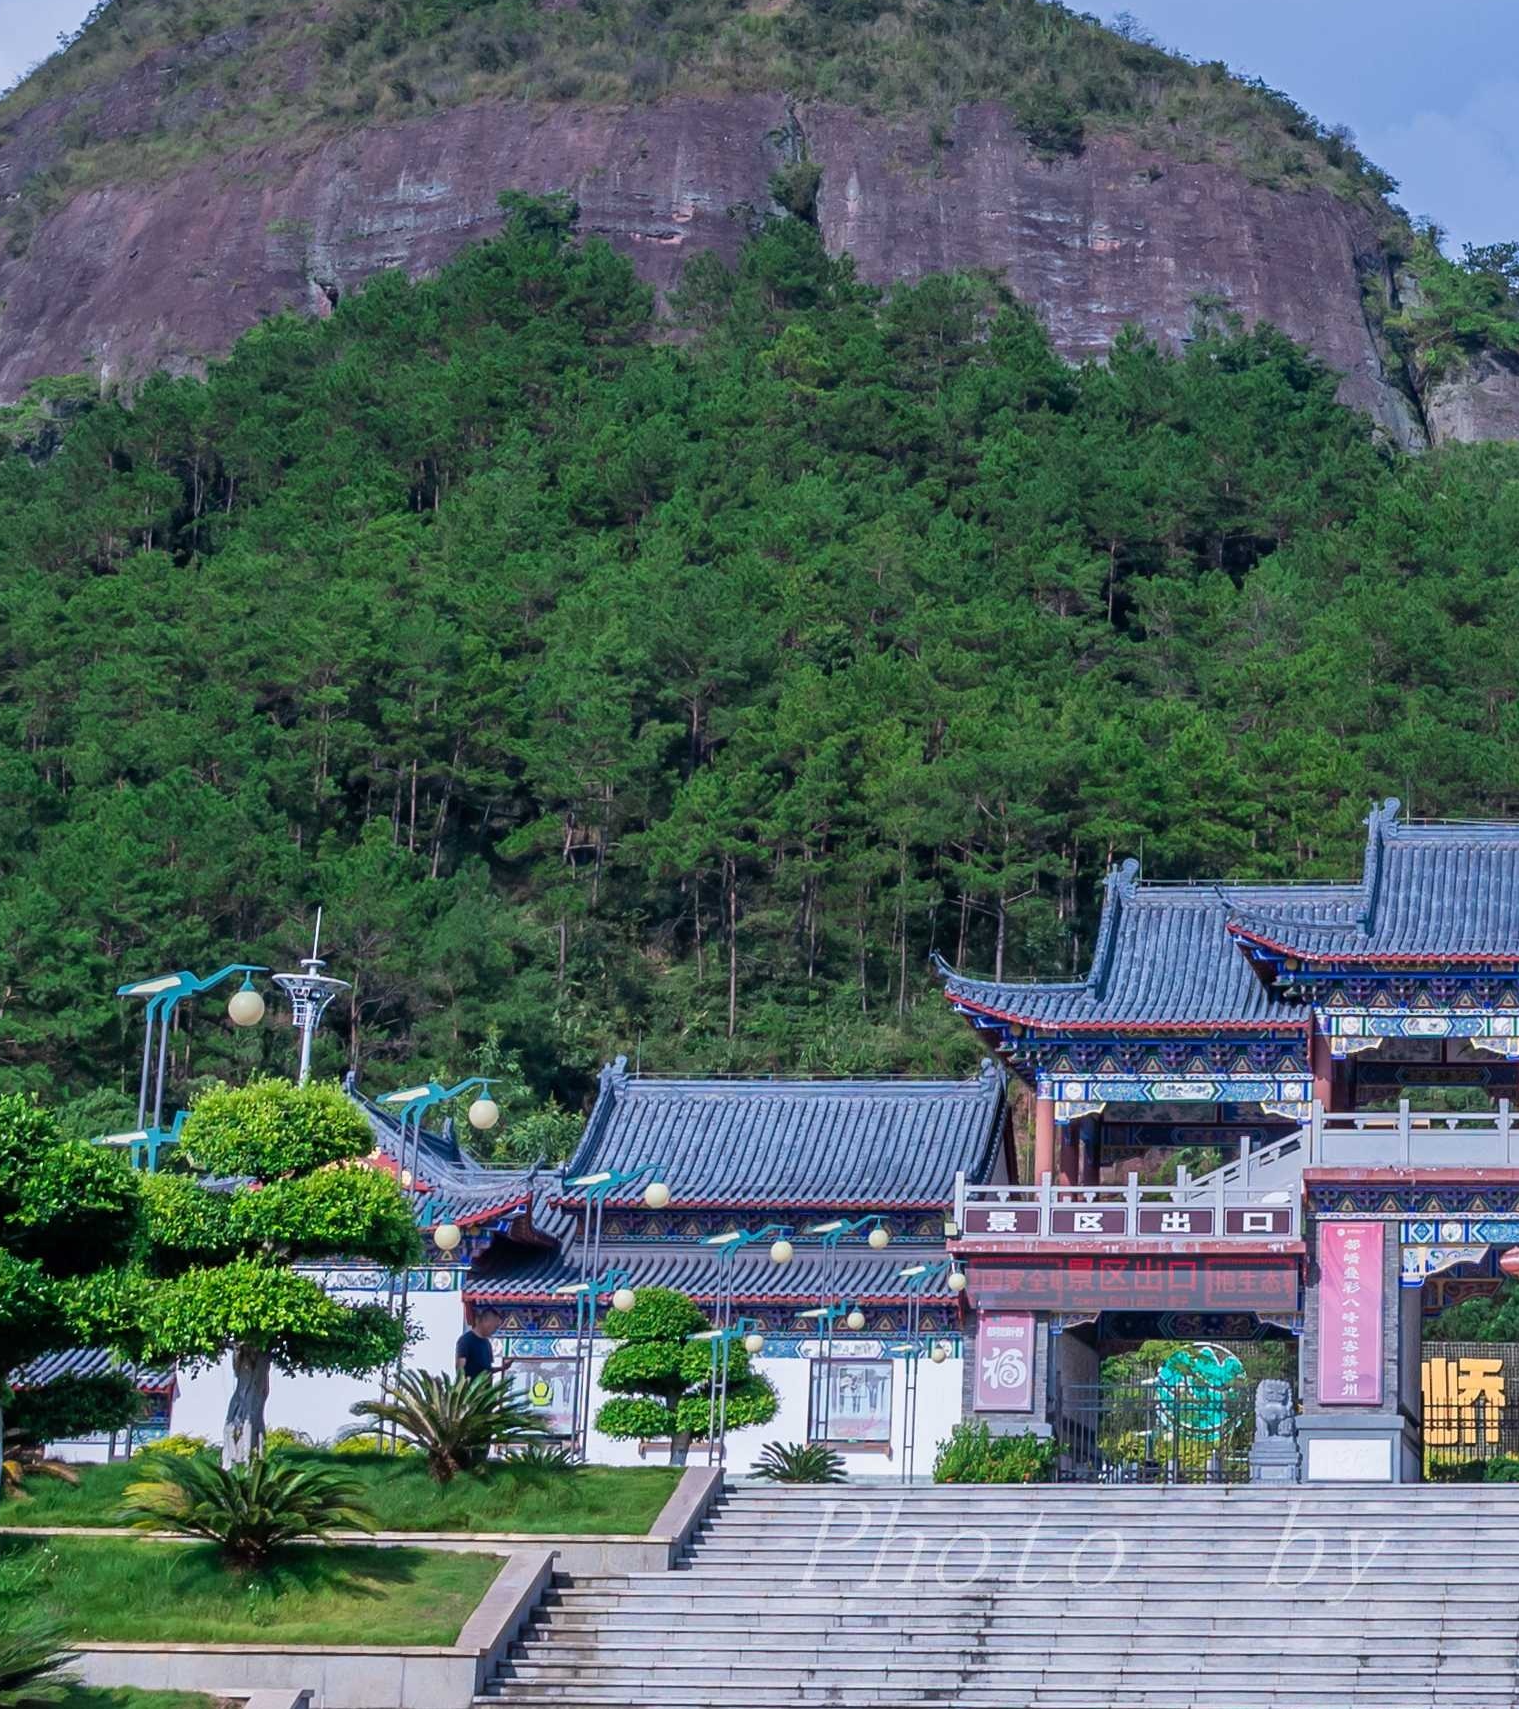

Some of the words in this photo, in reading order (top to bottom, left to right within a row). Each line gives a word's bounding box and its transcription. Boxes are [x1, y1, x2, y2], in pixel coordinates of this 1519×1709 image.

[986, 1211, 1274, 1233] 景区出口
[1068, 1258, 1197, 1291] 景区出口
[982, 1347, 1027, 1389] 福
